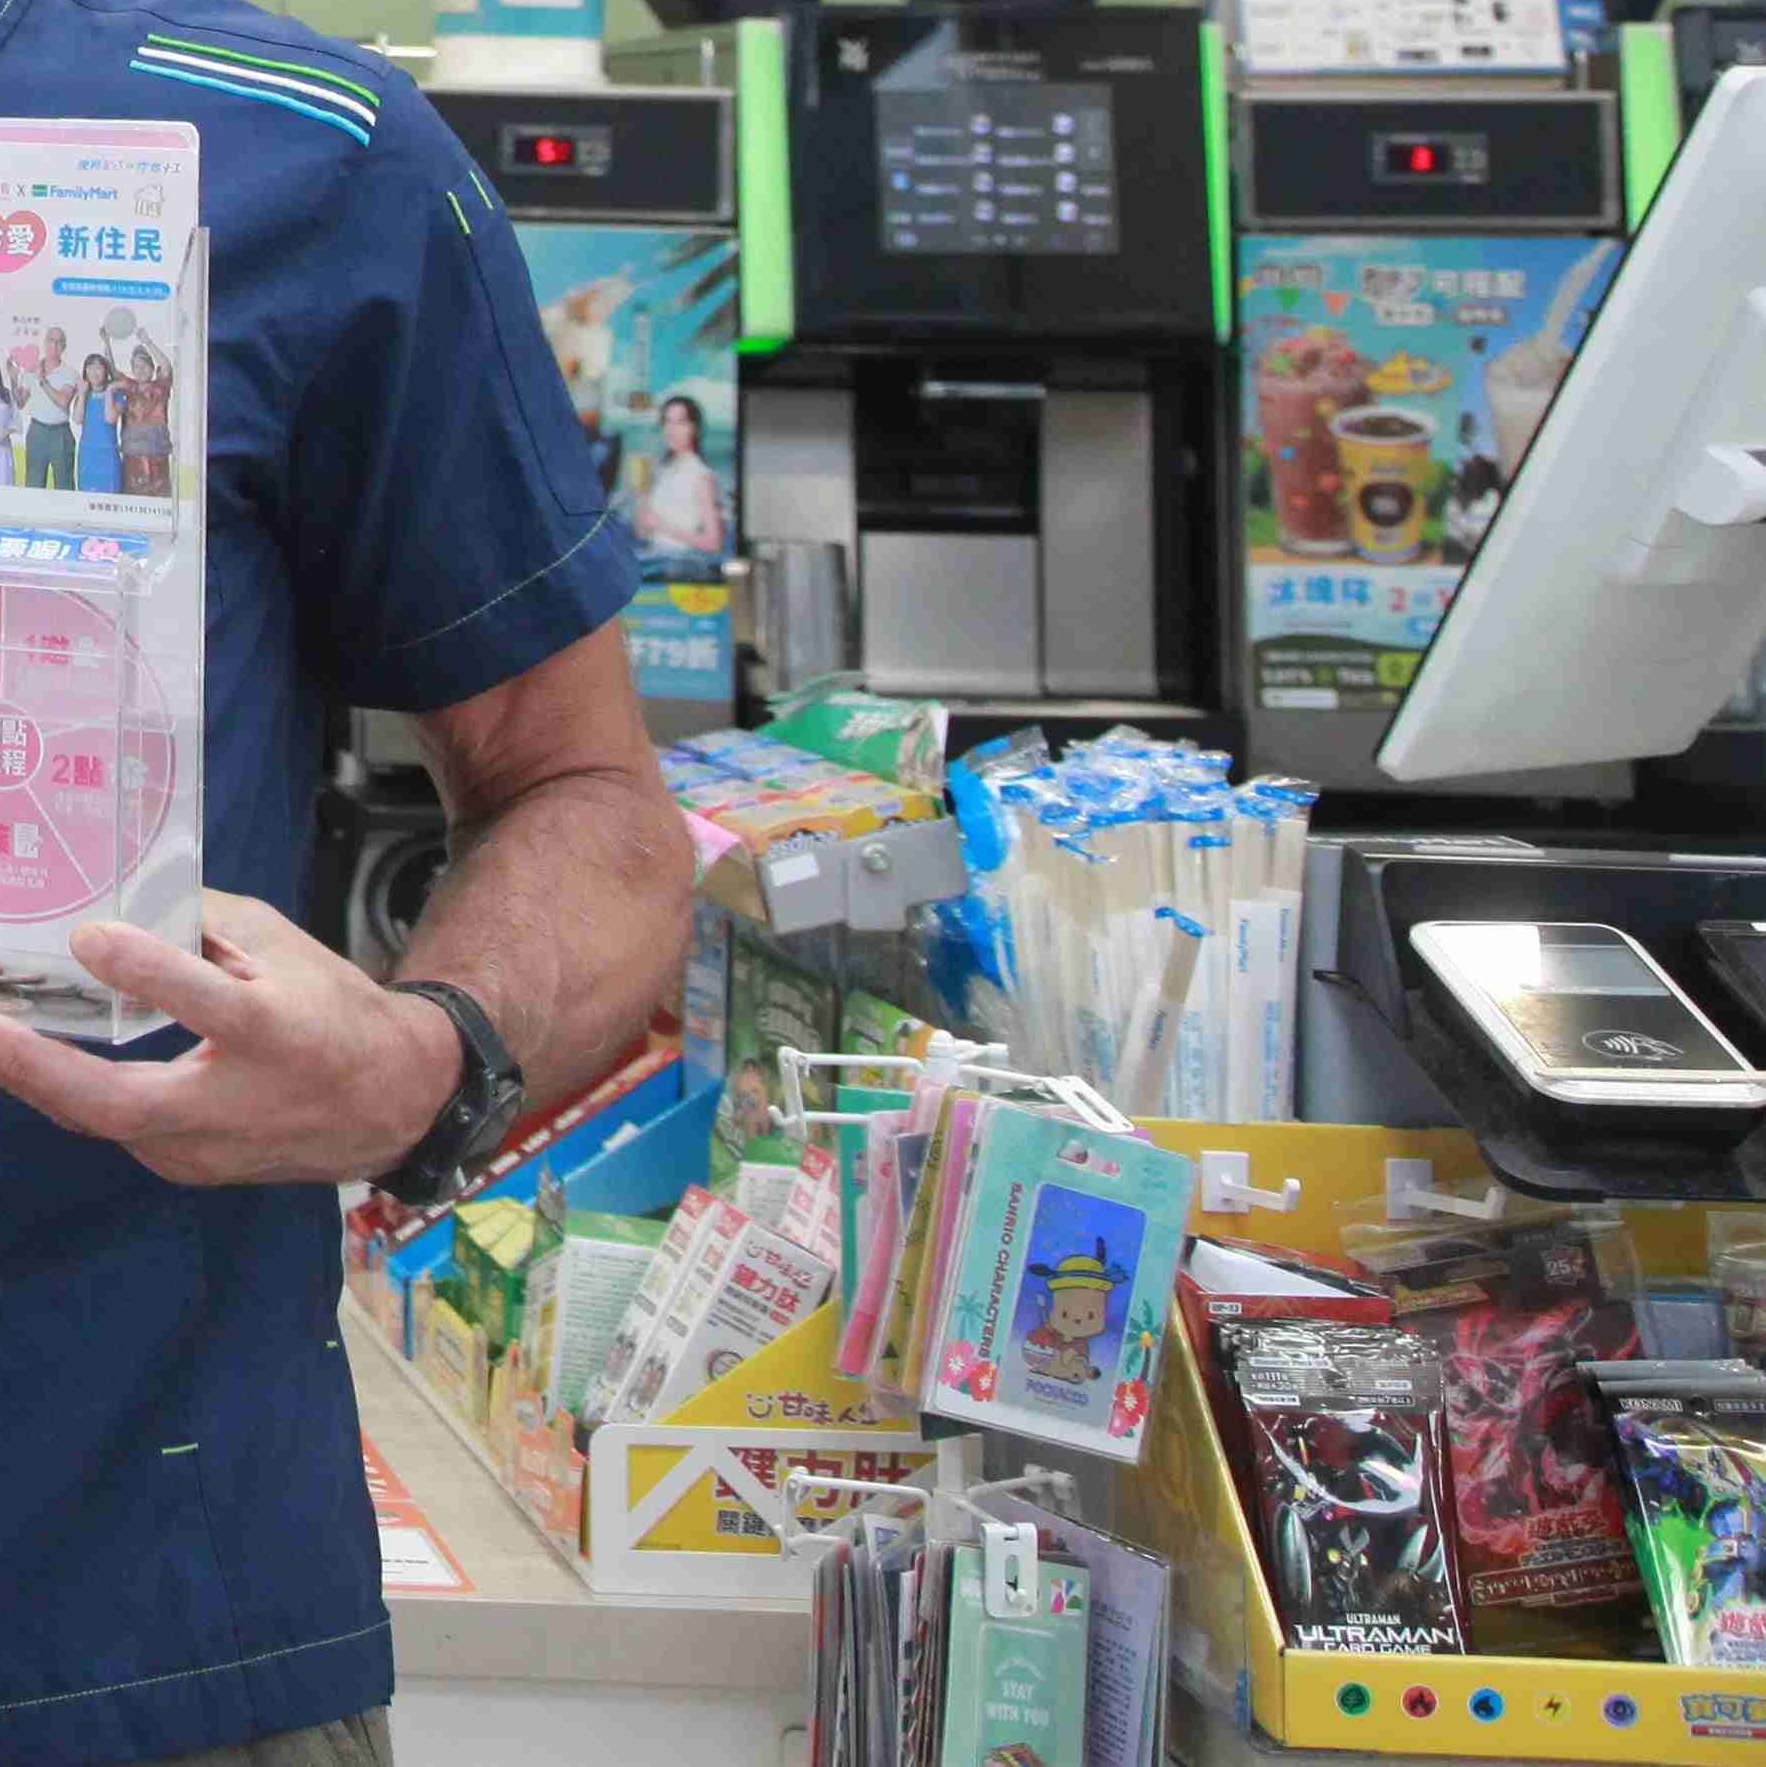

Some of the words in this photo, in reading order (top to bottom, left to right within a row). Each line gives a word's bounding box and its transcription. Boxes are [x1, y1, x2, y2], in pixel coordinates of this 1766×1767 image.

[49, 184, 118, 201] FamilyMart
[57, 223, 164, 264] 新住民
[978, 1249, 1010, 1358] CHARACTERS
[1345, 1612, 1402, 1625] ULTRAMAN
[1294, 1624, 1455, 1644] ULTRAMAN
